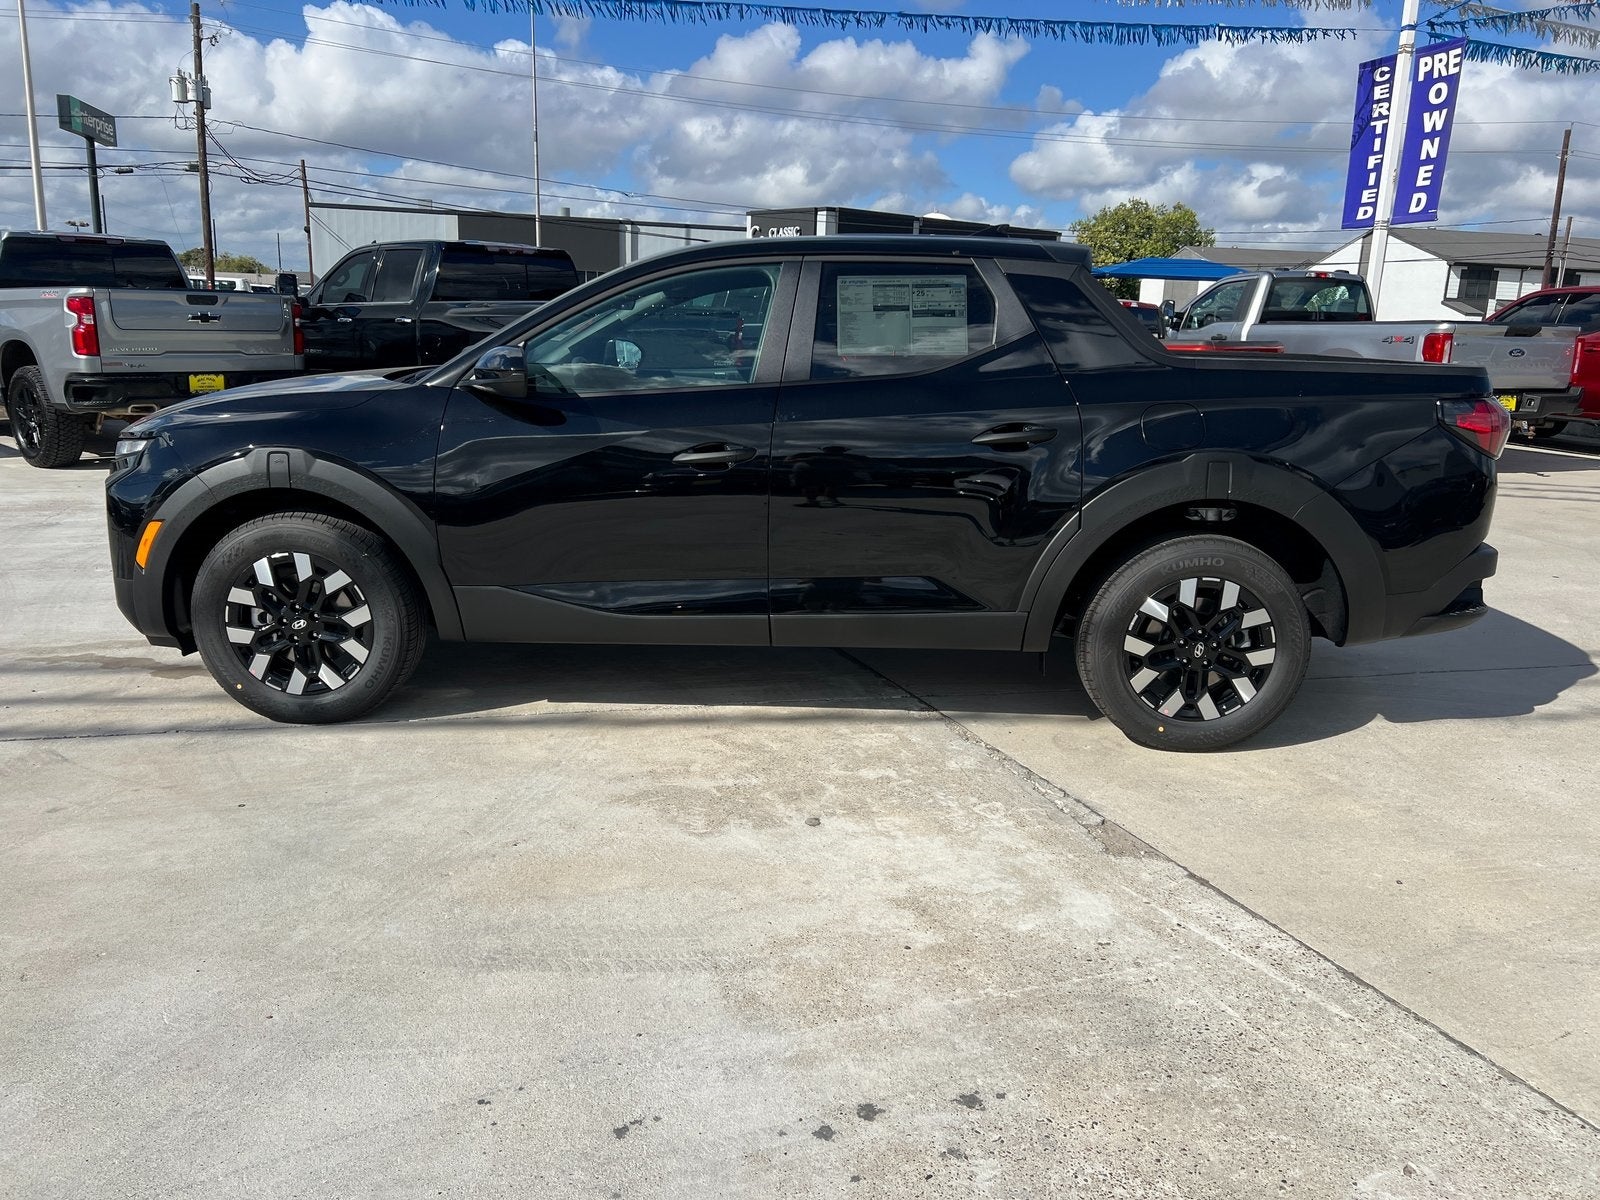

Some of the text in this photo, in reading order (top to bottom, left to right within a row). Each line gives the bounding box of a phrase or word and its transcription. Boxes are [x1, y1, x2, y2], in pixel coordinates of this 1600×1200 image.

[1418, 48, 1462, 82] PRE
[1356, 66, 1391, 220] CERTIFIED
[1408, 82, 1448, 213] OWNED
[769, 226, 800, 238] CLASSIC
[1160, 557, 1225, 575] KUMHO
[365, 636, 392, 689] KUMHO
